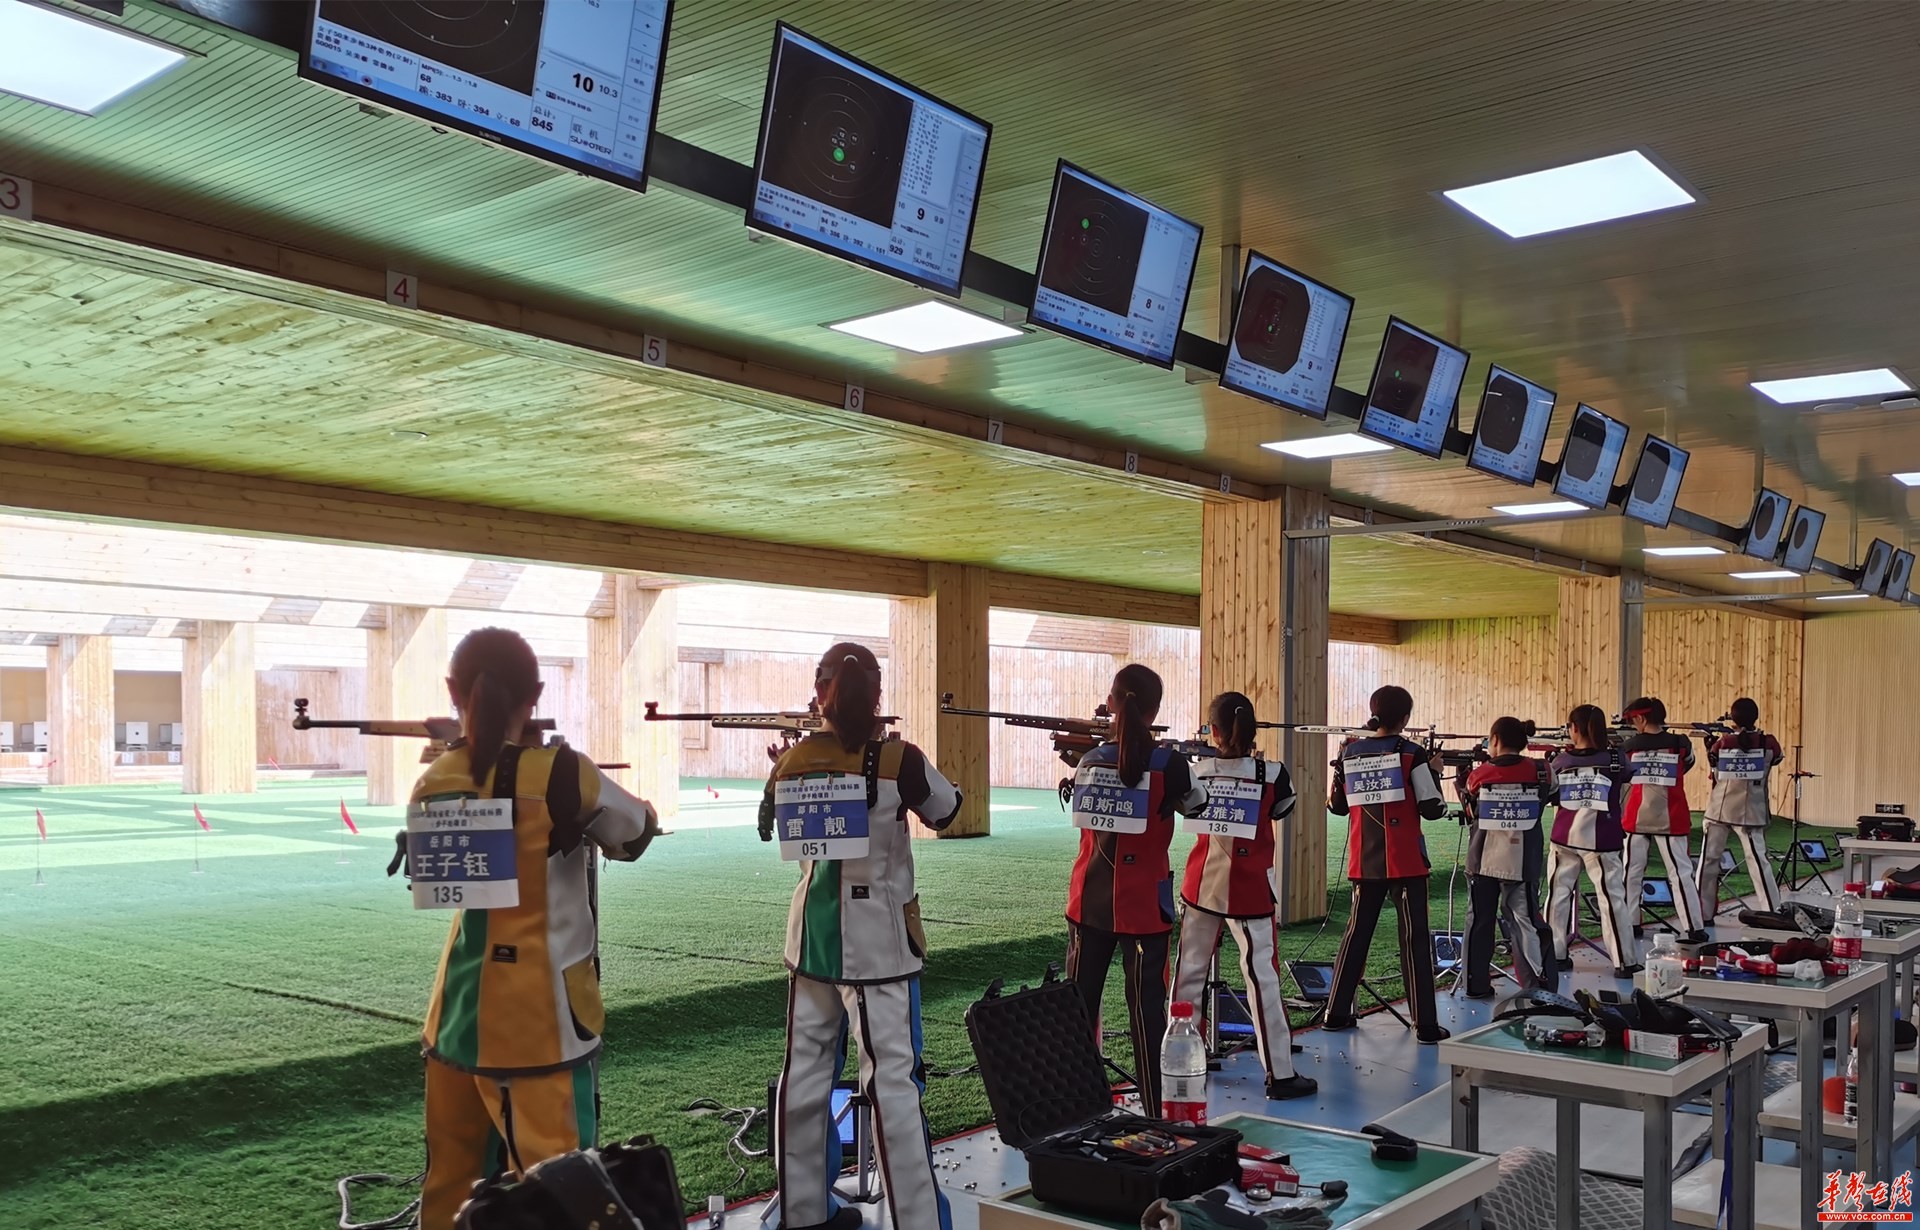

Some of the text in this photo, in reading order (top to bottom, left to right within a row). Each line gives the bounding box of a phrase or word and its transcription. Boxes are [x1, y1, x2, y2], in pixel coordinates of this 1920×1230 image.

[420, 73, 432, 83] 68
[572, 72, 595, 94] 10
[599, 84, 618, 99] 10.3
[435, 91, 452, 103] 383
[473, 104, 490, 116] 394
[509, 117, 521, 127] 68
[531, 116, 553, 132] 845
[0, 178, 20, 210] 3
[917, 207, 925, 221] 9
[889, 244, 903, 256] 929
[392, 277, 410, 303] 4
[1145, 298, 1152, 310] 8
[647, 339, 660, 361] 5
[1307, 360, 1313, 370] 9
[850, 388, 860, 409] 6
[992, 423, 1000, 441] 7
[1127, 455, 1135, 472] 8
[1221, 477, 1229, 492] 9
[1353, 777, 1392, 793] 吴汝萍
[1365, 793, 1382, 802] 079
[1079, 796, 1133, 815] 周斯鸣
[1091, 816, 1115, 829] 078
[1208, 823, 1228, 833] 136
[1501, 821, 1517, 829] 044
[429, 834, 470, 848] 岳阳市
[802, 842, 828, 856] 051
[416, 851, 490, 878] 王子钰
[433, 885, 464, 904] 135
